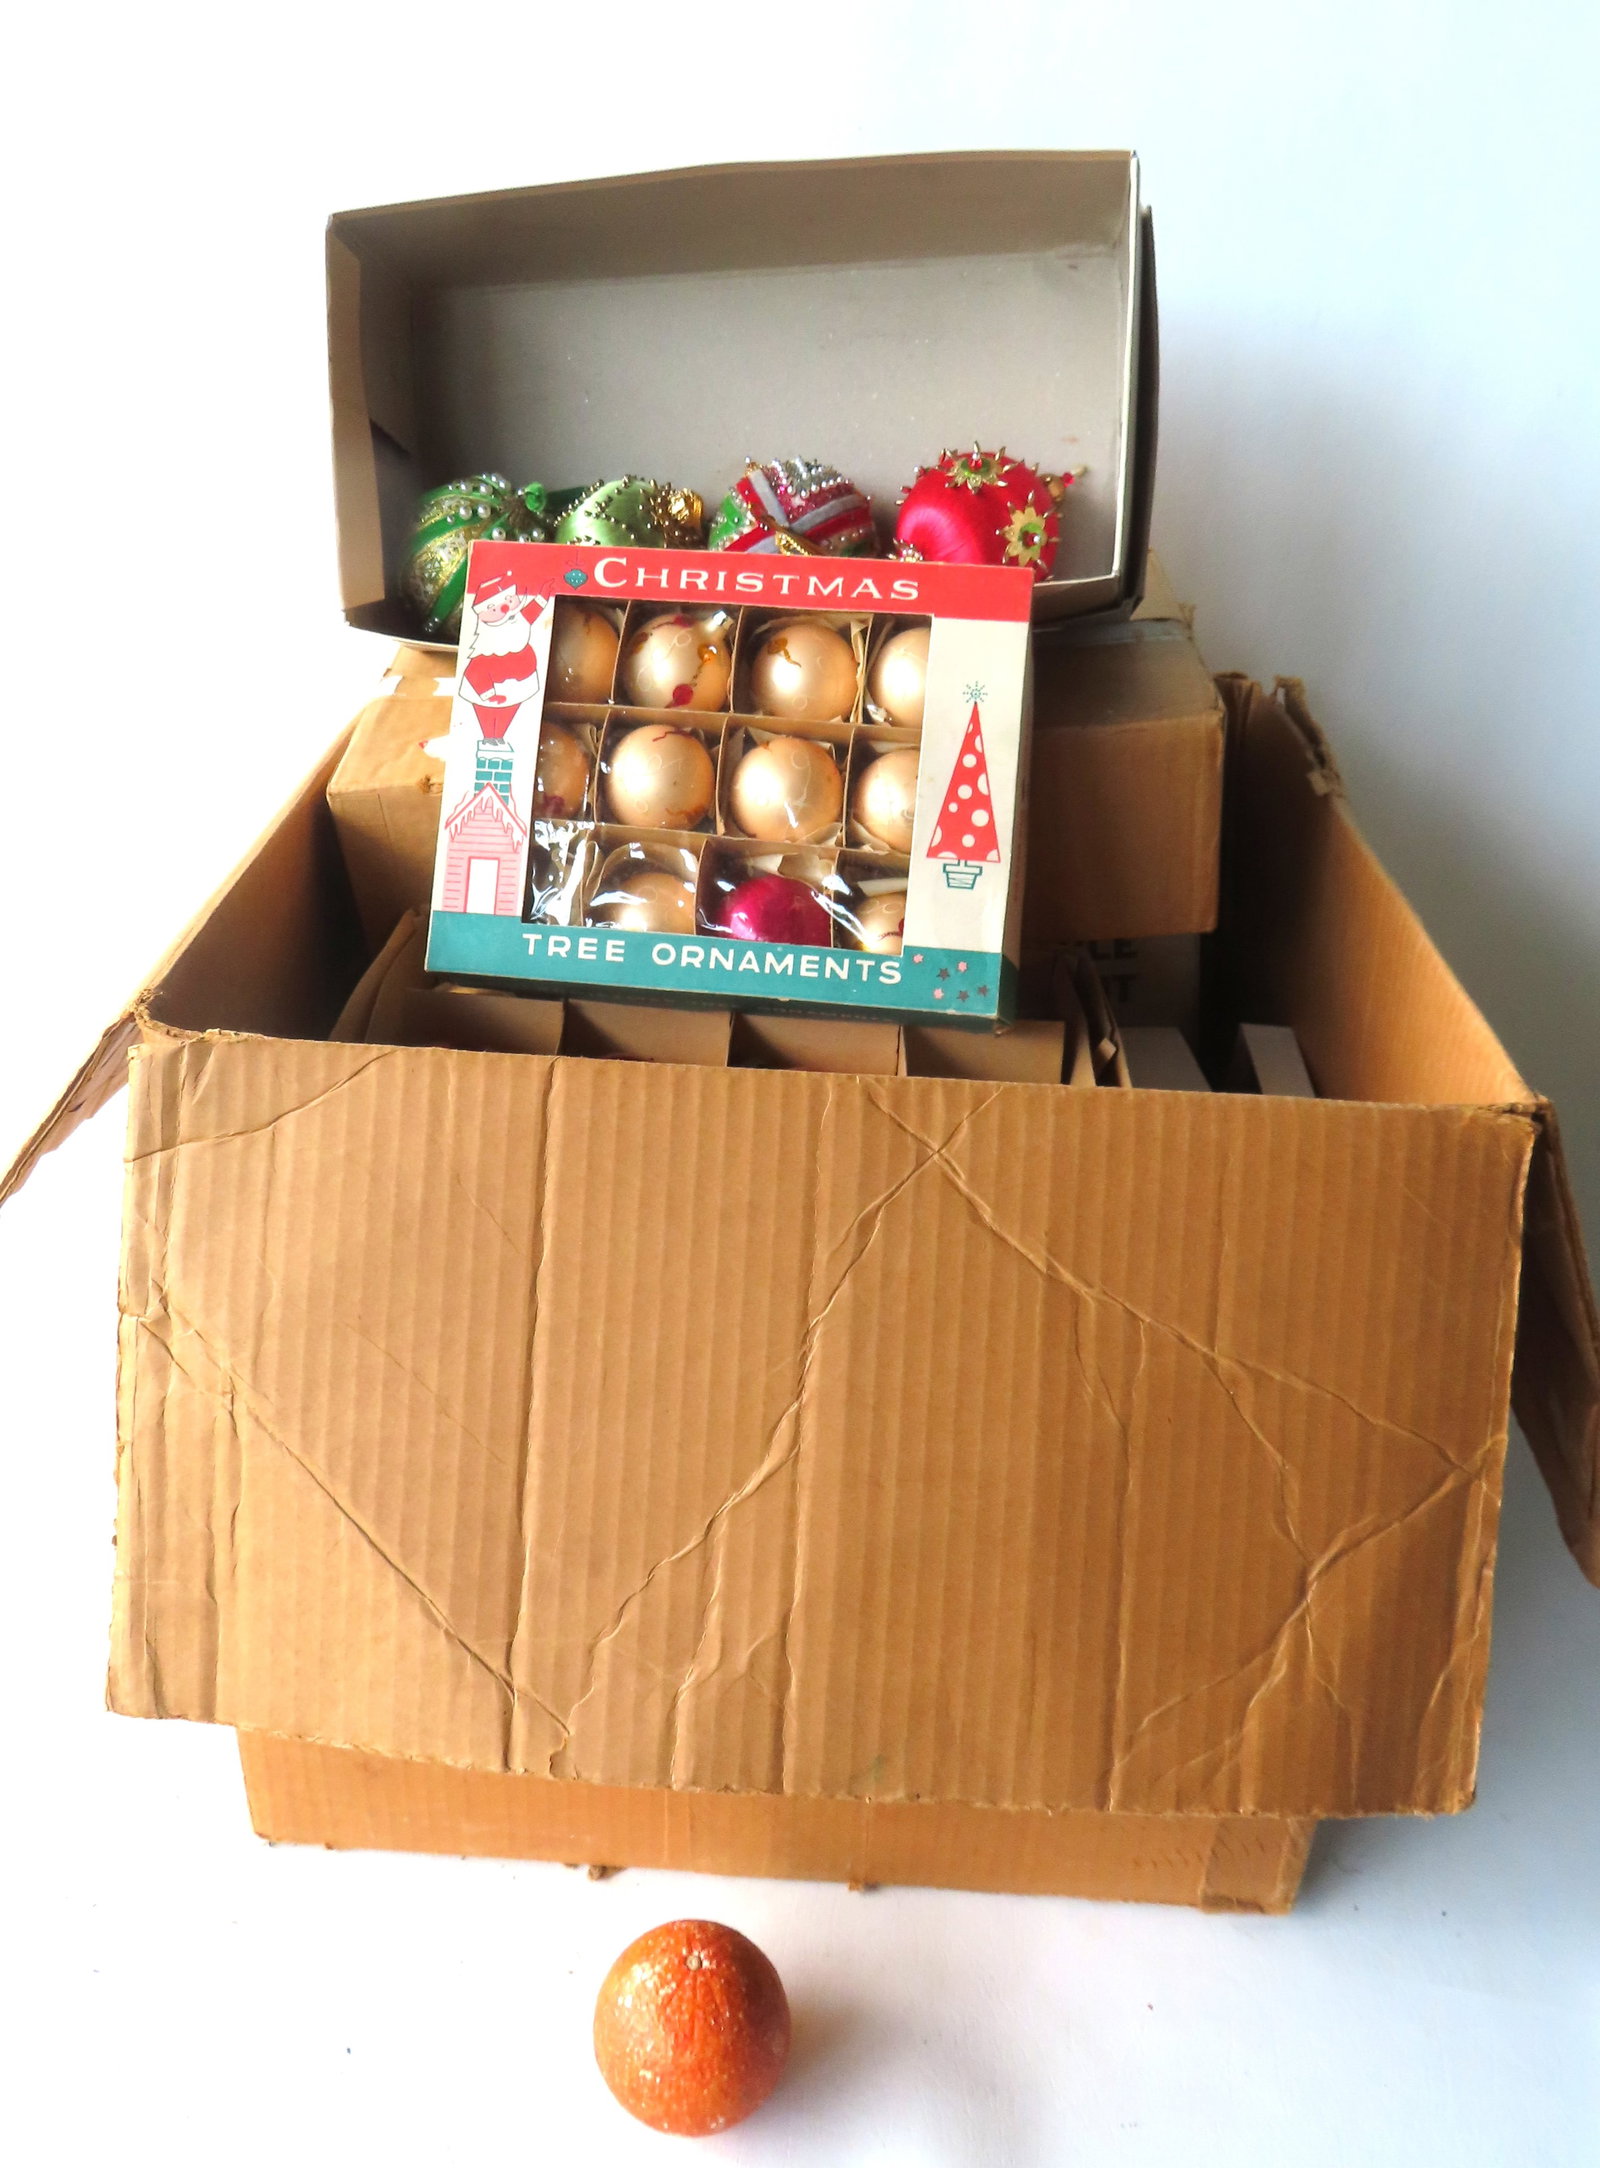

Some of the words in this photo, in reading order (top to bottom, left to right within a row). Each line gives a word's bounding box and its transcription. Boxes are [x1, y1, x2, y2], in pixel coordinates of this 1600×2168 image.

[593, 557, 919, 600] CHRISTMAS
[522, 933, 626, 962] TREE
[651, 943, 902, 985] ORNAMENTS
